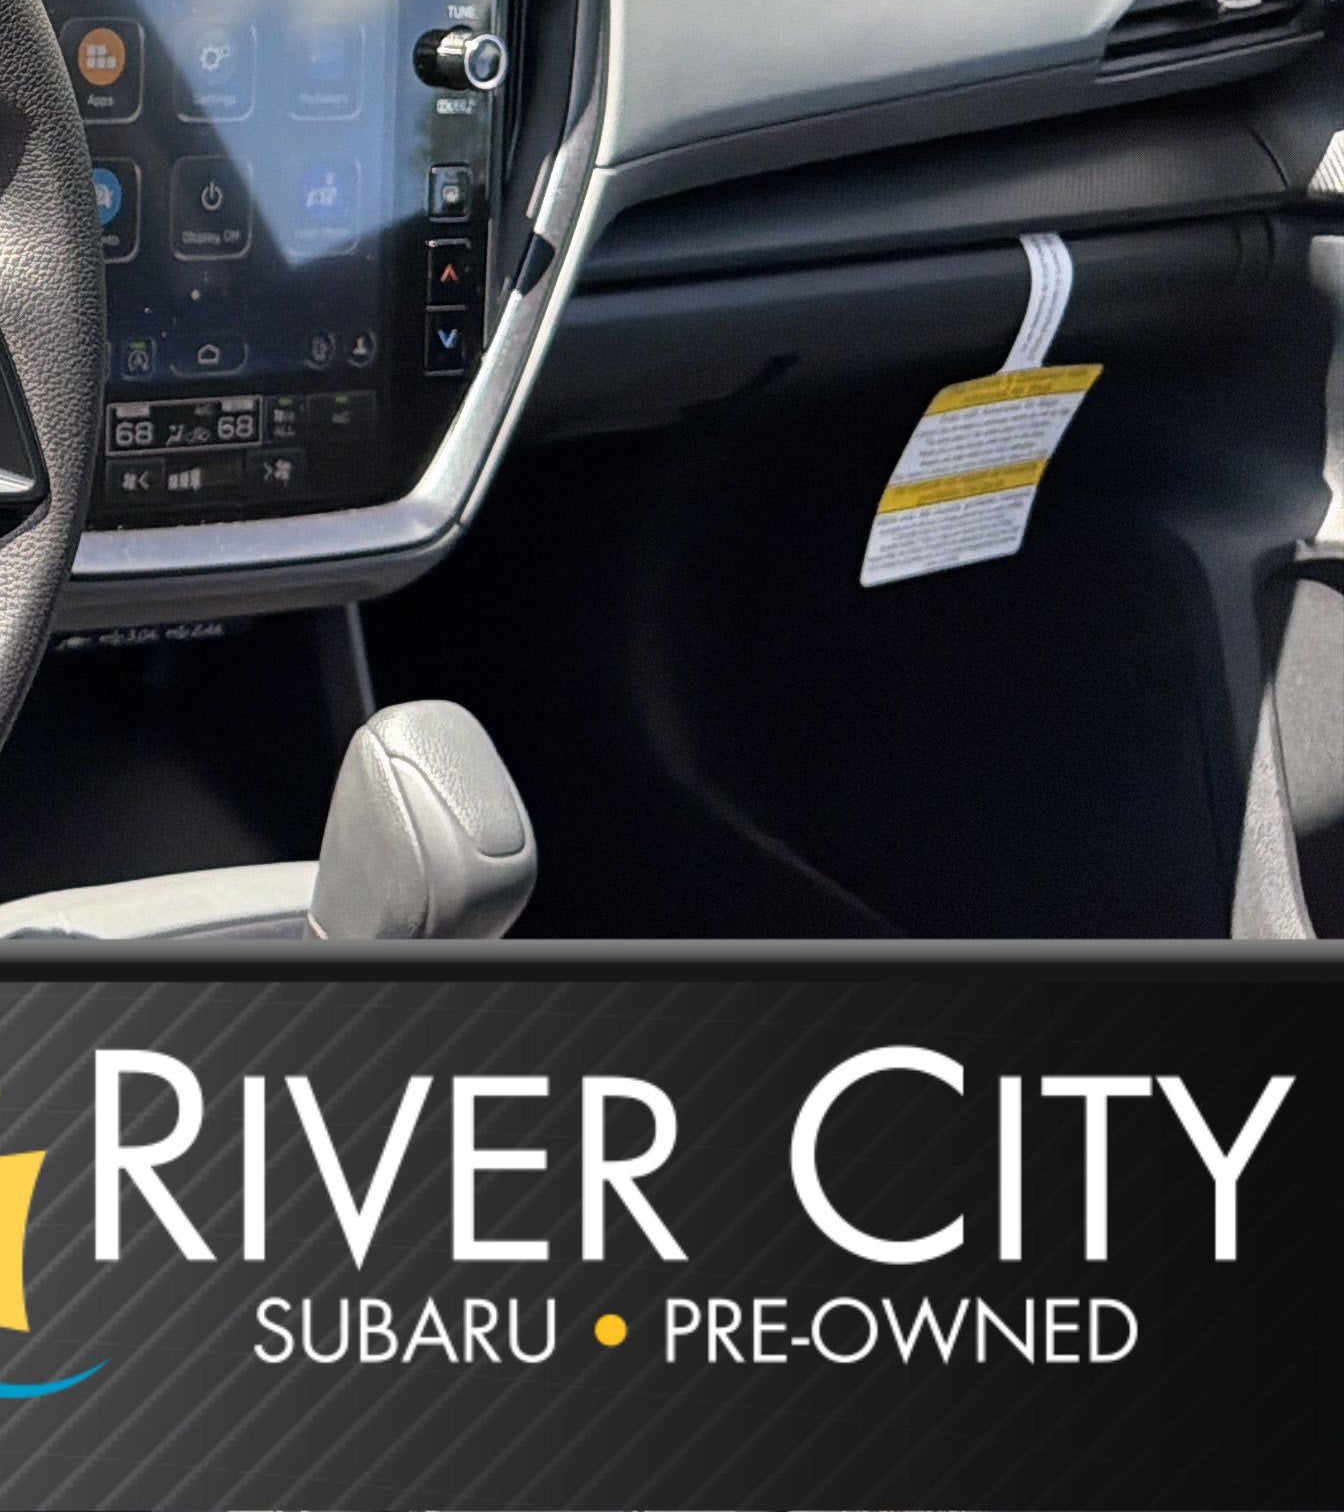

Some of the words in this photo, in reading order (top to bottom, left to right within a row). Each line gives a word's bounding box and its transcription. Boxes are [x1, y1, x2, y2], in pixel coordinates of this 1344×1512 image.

[447, 4, 477, 19] TUNE
[115, 421, 154, 447] 68
[217, 414, 253, 439] 68
